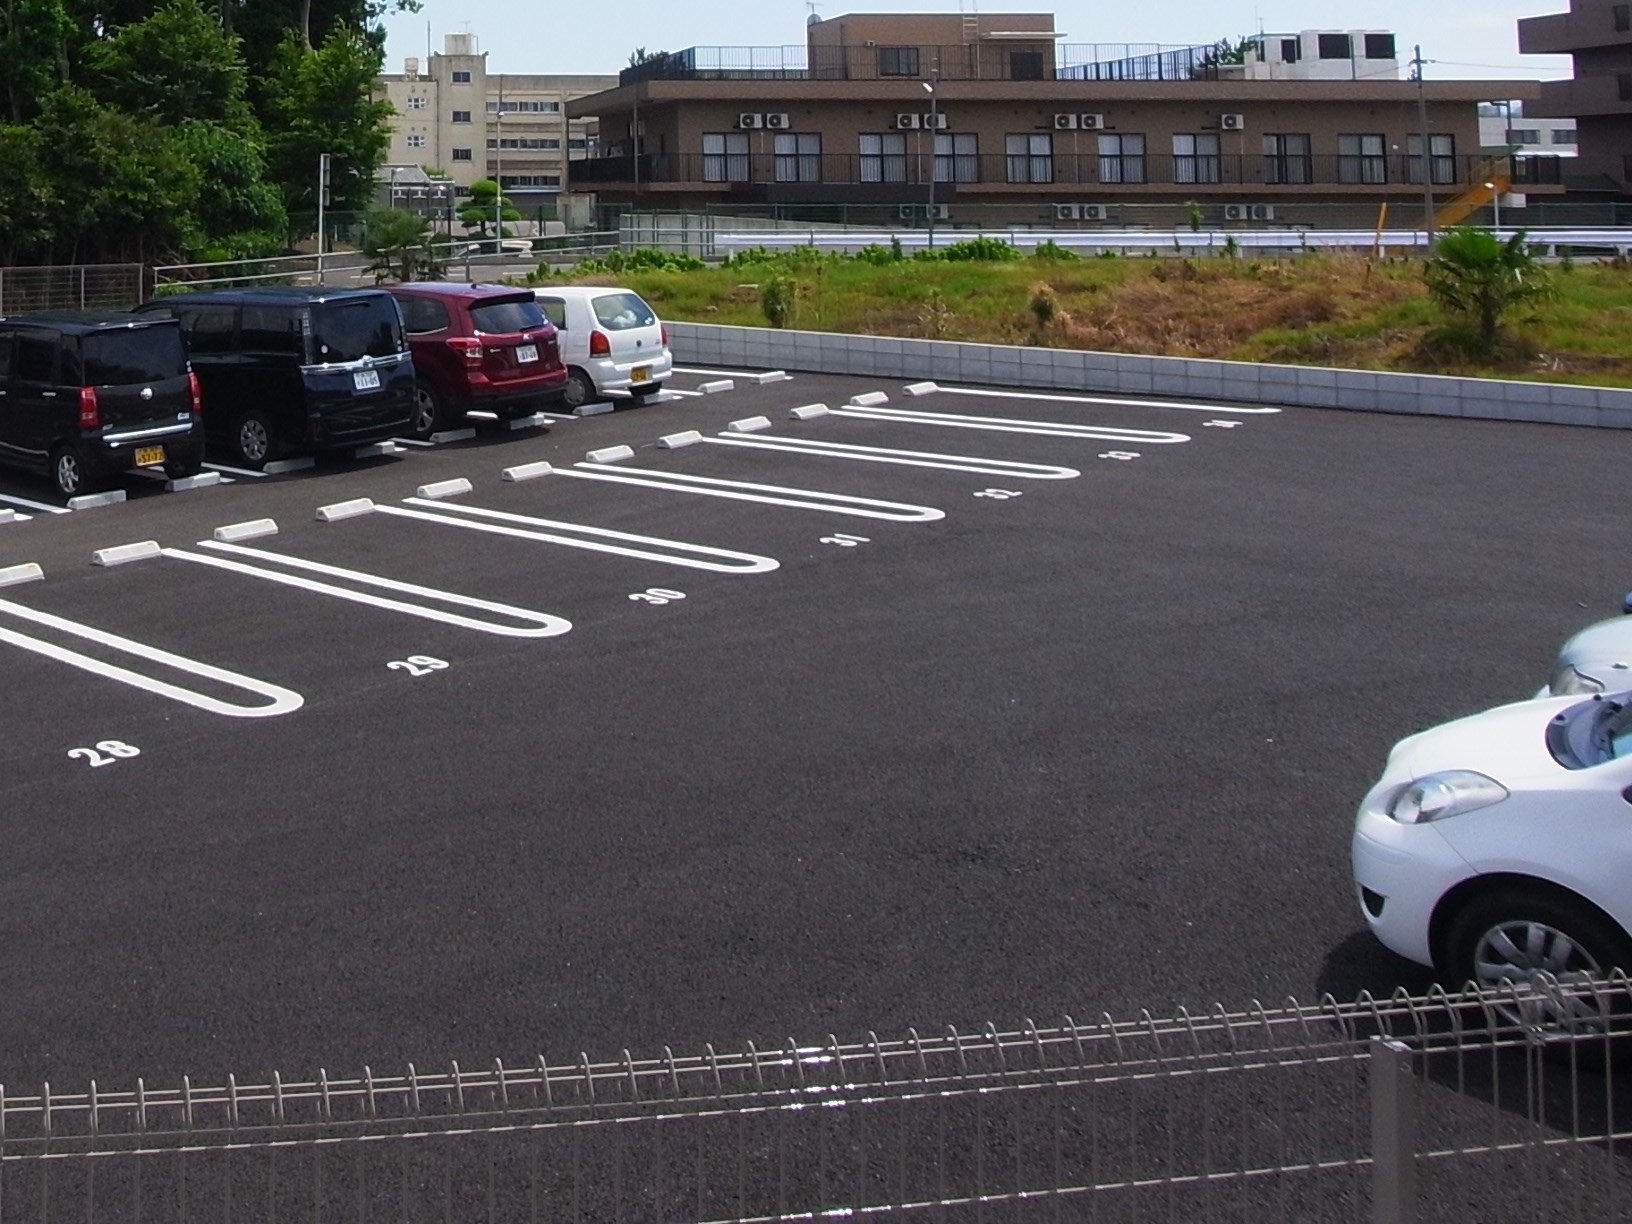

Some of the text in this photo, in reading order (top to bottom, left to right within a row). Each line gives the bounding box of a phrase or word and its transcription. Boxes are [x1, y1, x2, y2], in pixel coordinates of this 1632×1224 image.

[973, 488, 1023, 499] 32
[820, 533, 871, 546] 31
[629, 587, 687, 605] 30
[386, 655, 450, 676] 29
[67, 741, 141, 767] 28
